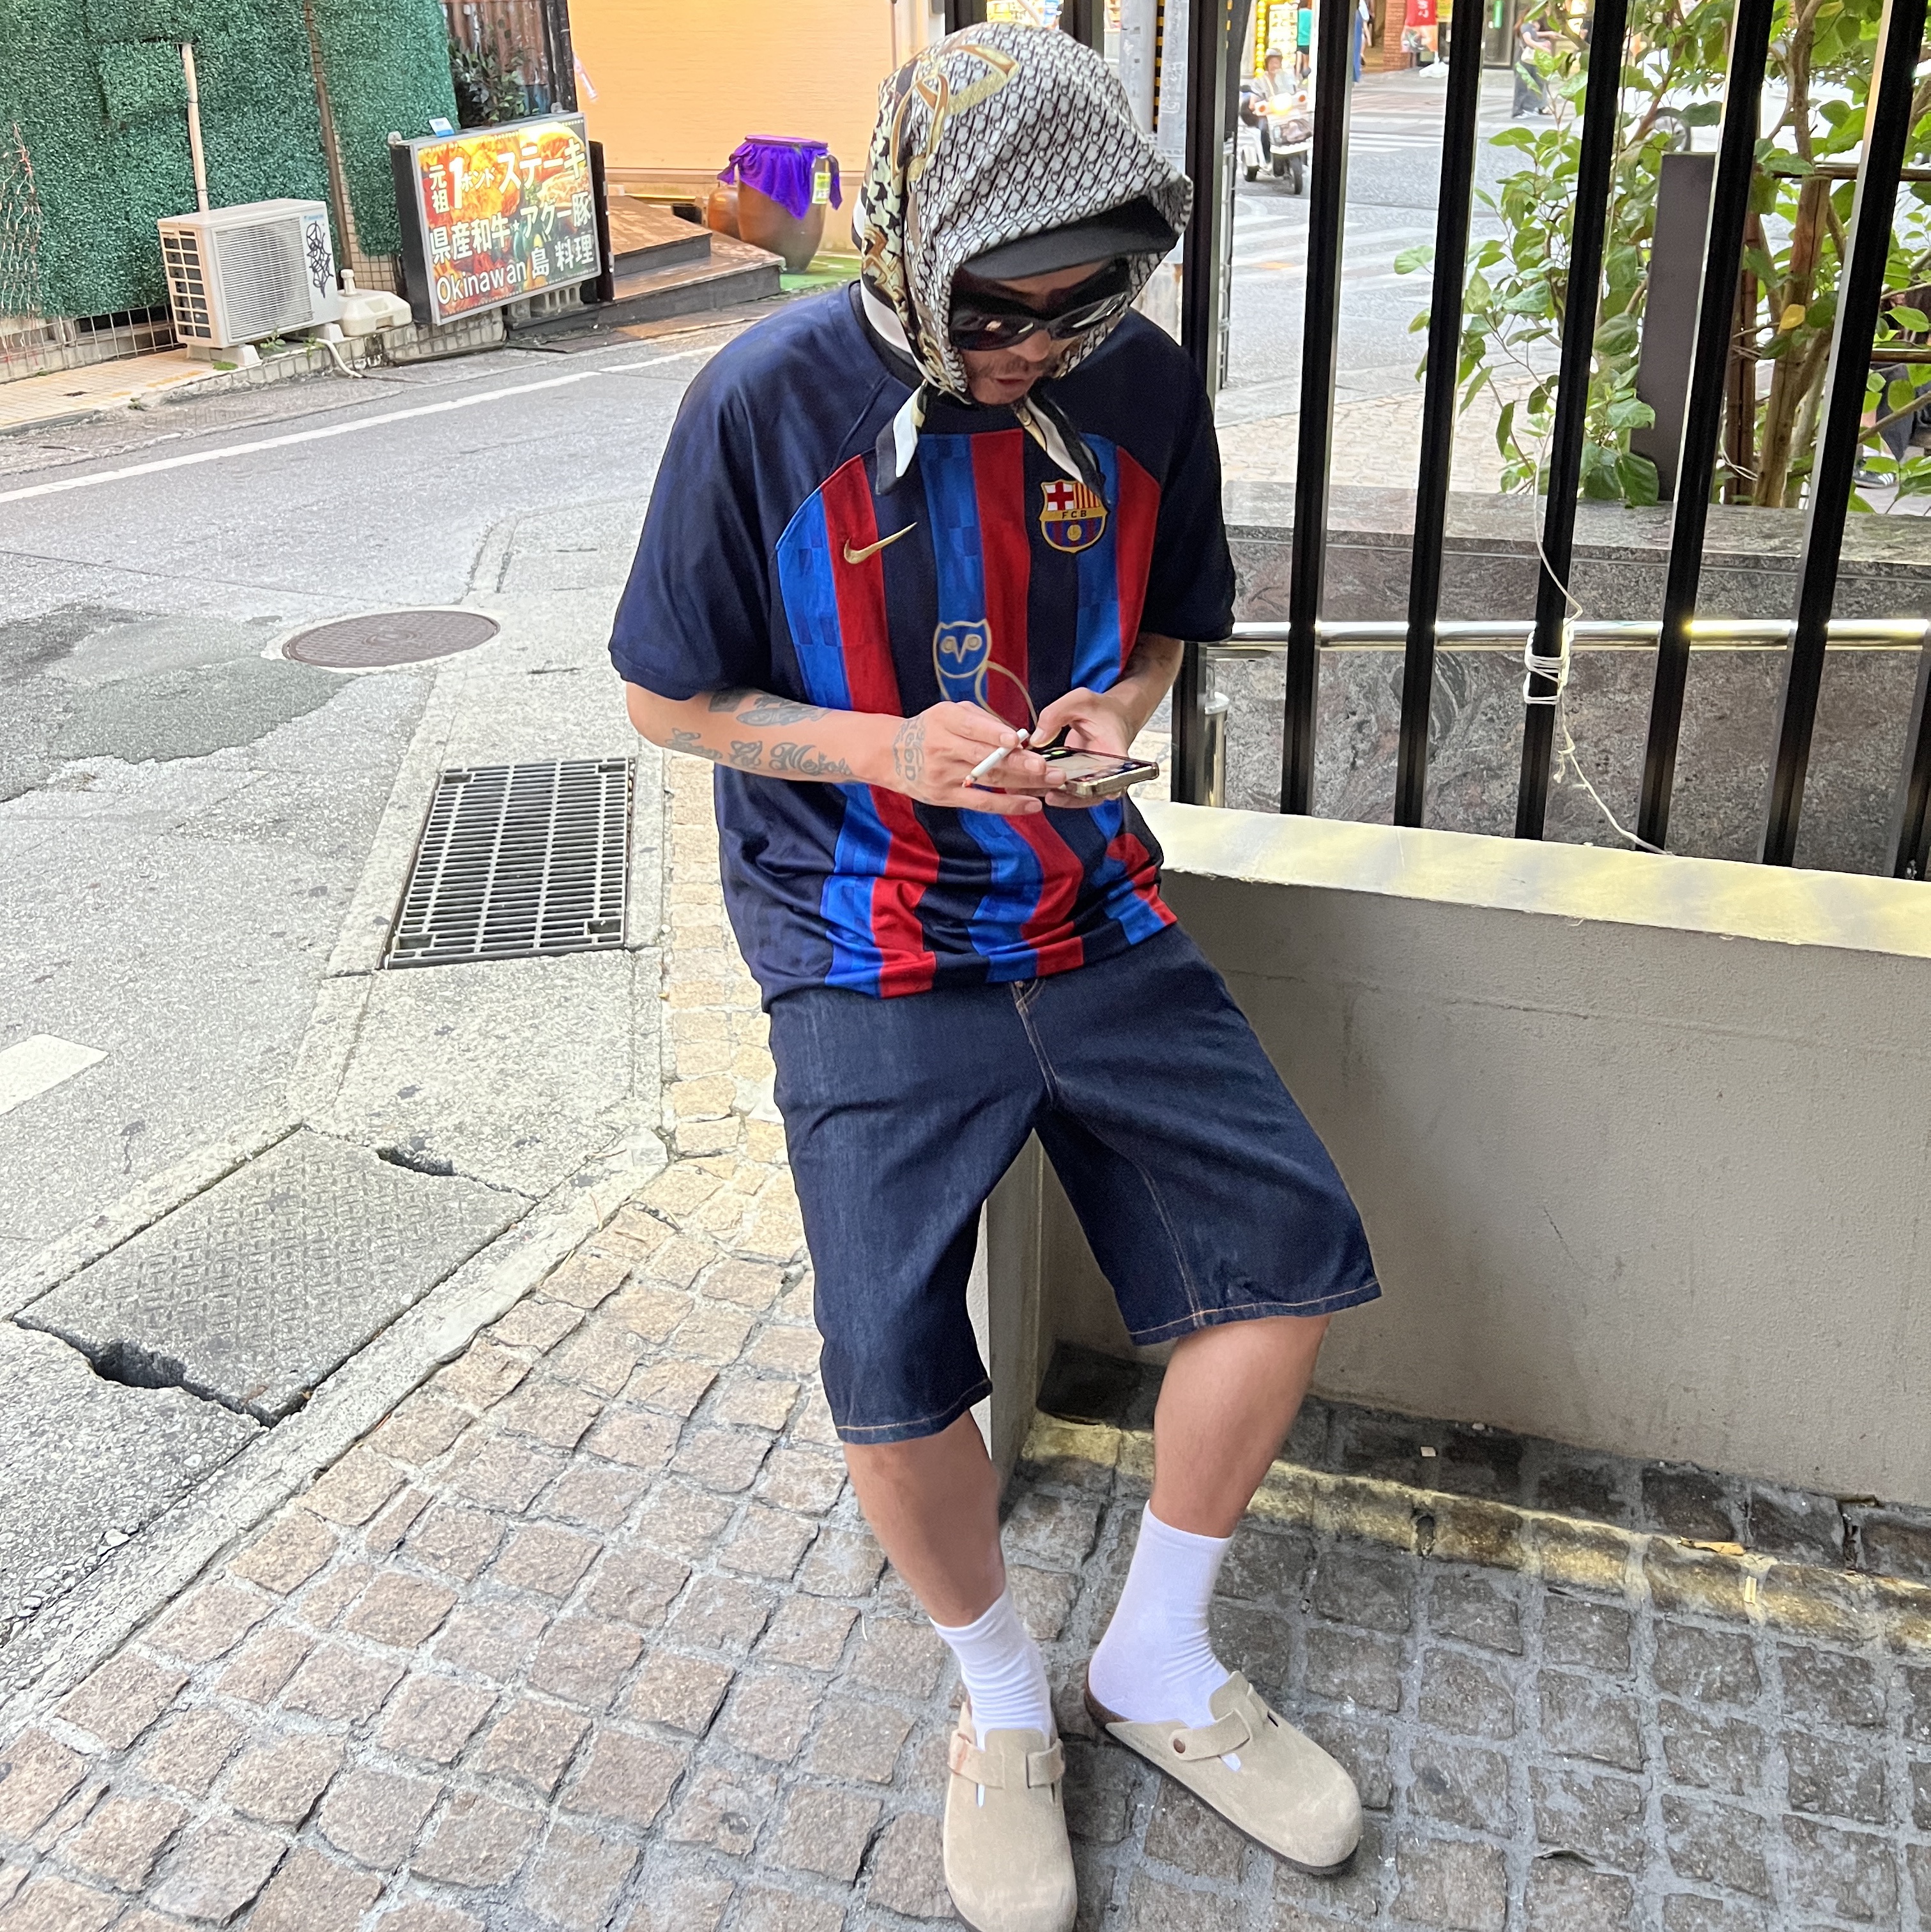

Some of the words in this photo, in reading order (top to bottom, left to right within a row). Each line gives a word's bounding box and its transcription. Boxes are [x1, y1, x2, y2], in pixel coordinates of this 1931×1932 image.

[429, 164, 450, 214] 元祖
[436, 261, 528, 305] Okinawan
[531, 247, 550, 280] 島
[554, 234, 595, 271] 料理
